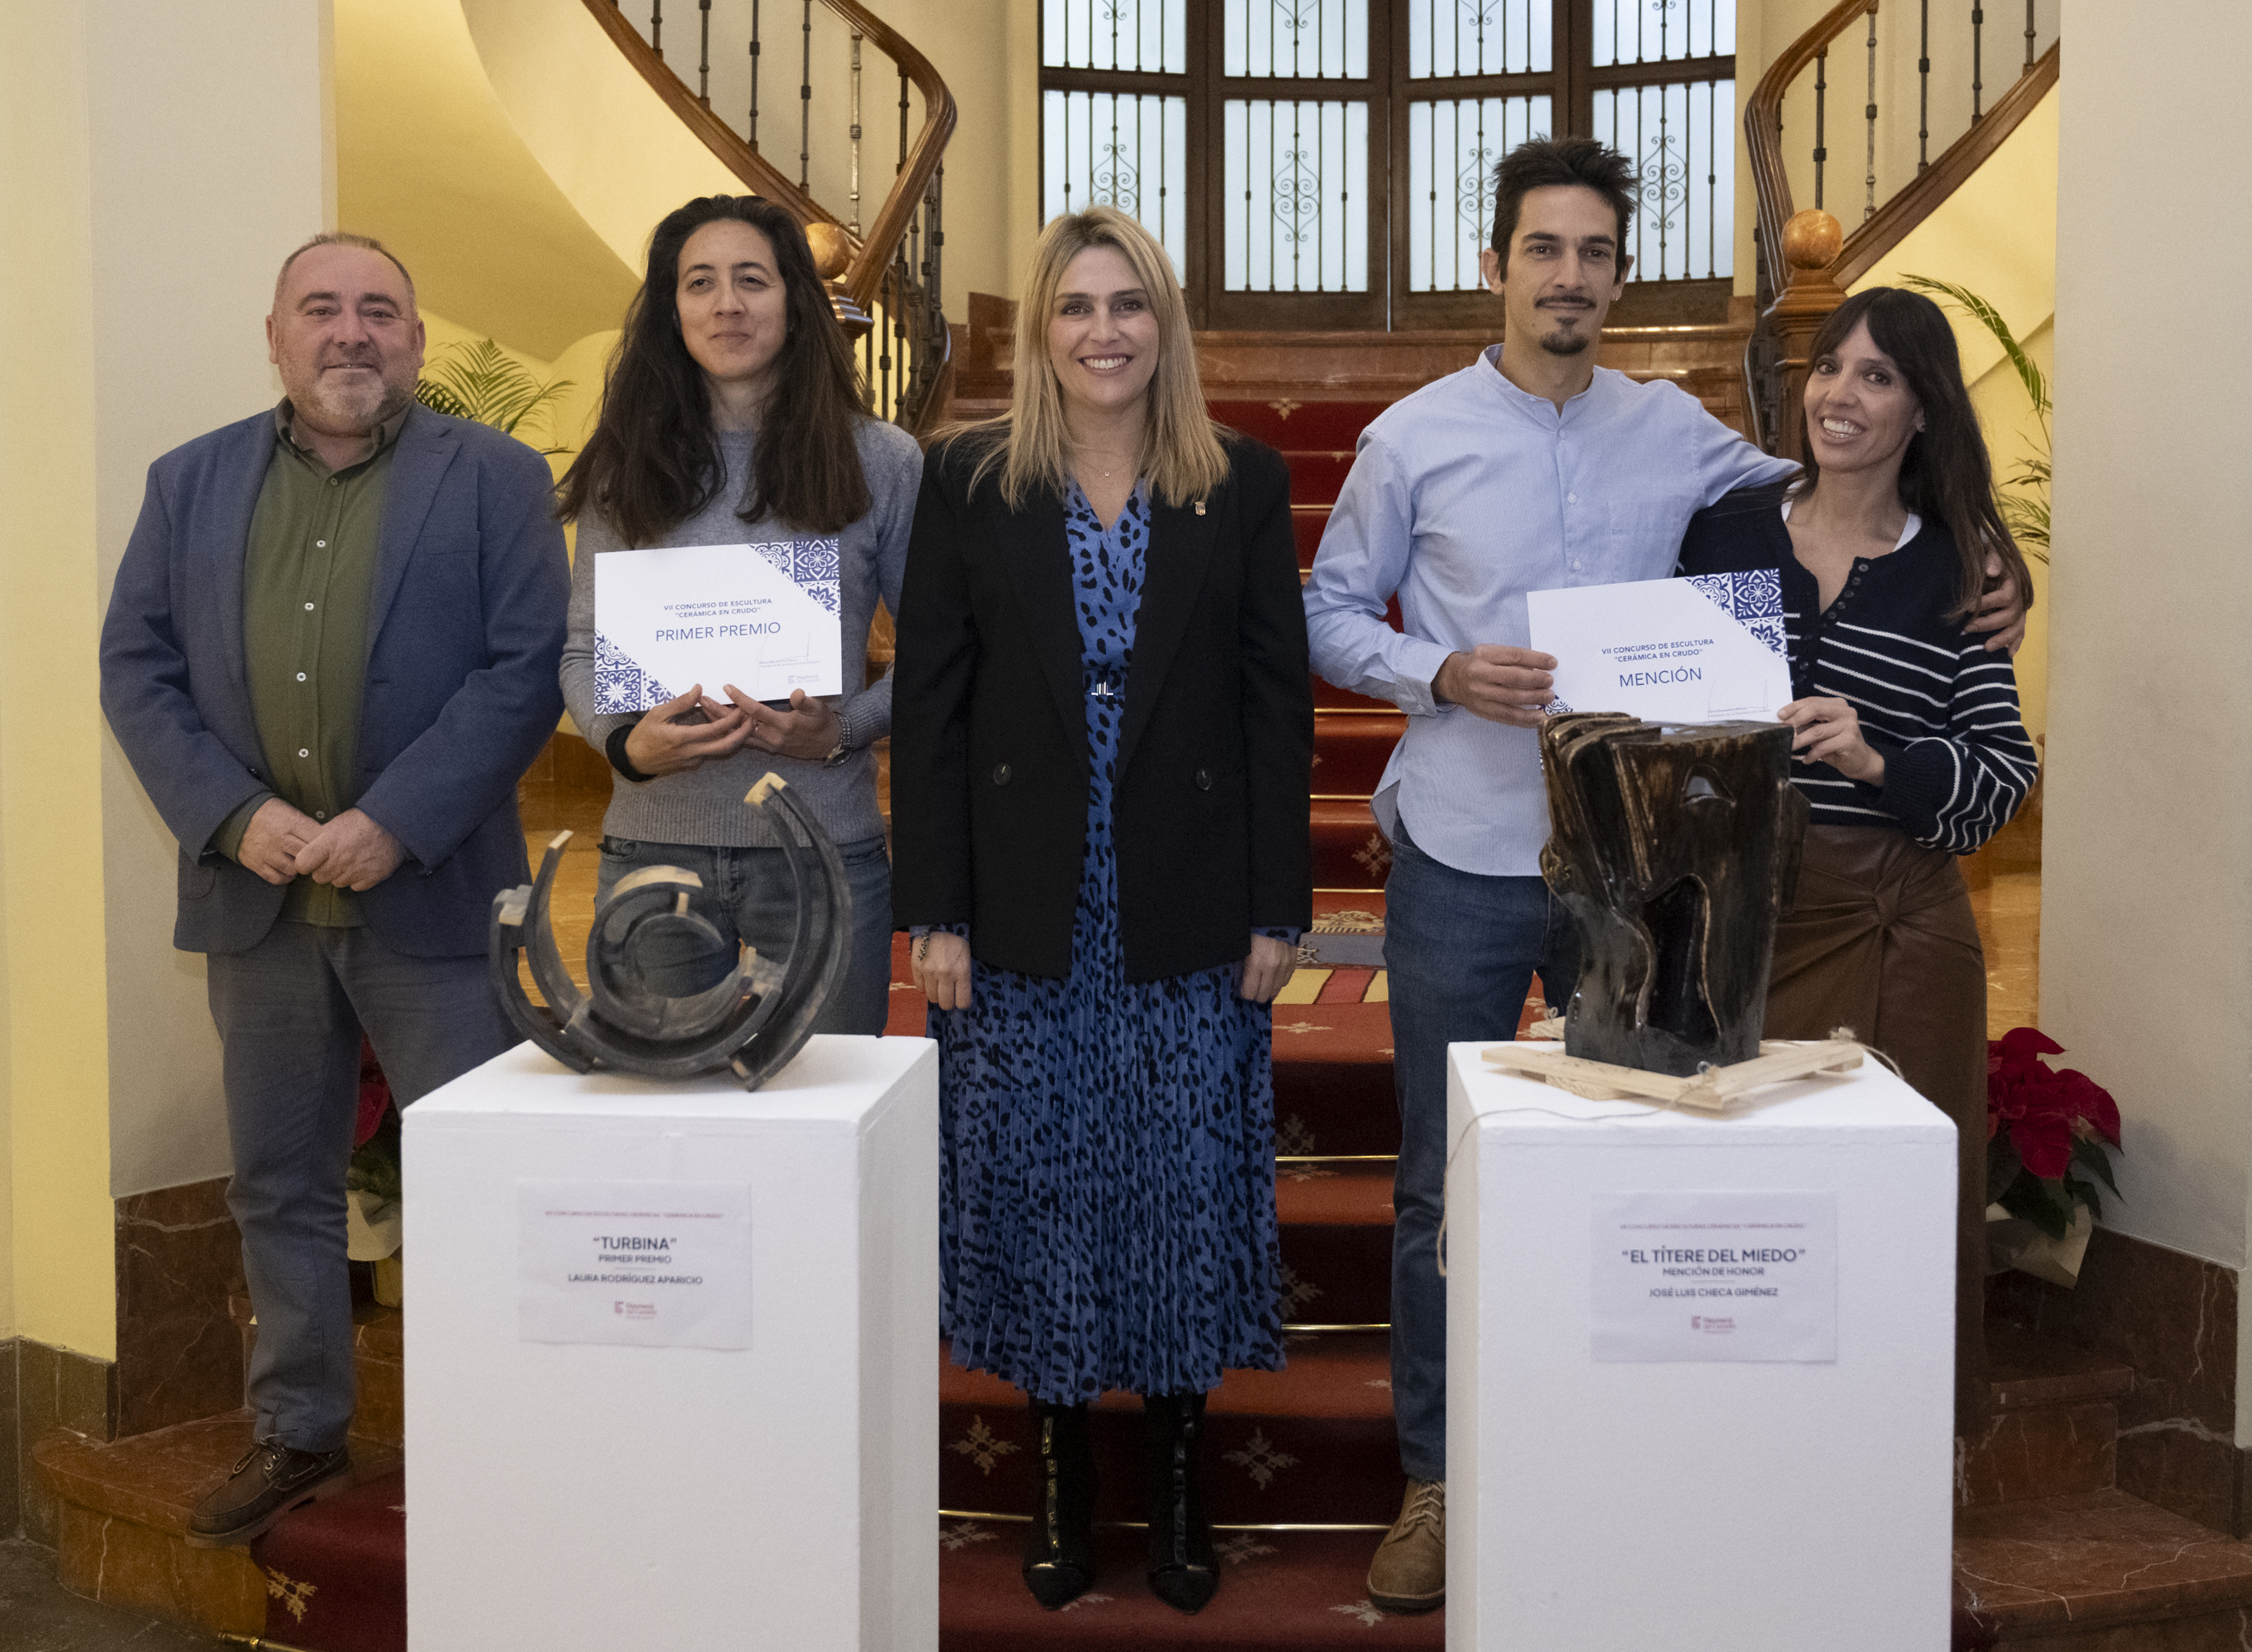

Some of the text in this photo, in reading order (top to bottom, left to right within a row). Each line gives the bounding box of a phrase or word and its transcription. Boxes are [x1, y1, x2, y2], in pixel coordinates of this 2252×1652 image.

[676, 601, 716, 611] CONCURSO
[656, 621, 781, 642] PRIMER PREMIO
[1614, 644, 1656, 654] CONCURSO
[1671, 638, 1714, 649] ESCULTURA
[1672, 649, 1702, 657] CRUDO"
[1620, 665, 1702, 688] MENCIÓN
[599, 1254, 671, 1264] PRIMER PREMIO
[1652, 1245, 1704, 1263] TÍTERE
[1708, 1249, 1738, 1263] DEL
[1663, 1264, 1710, 1276] MENCIÓN
[1727, 1267, 1764, 1276] HONOR
[568, 1272, 703, 1285] LAURA RODRÍGUEZ APARICIO
[1650, 1285, 1777, 1297] JOSÉ LUIS CHECA GIMÉNEZ
